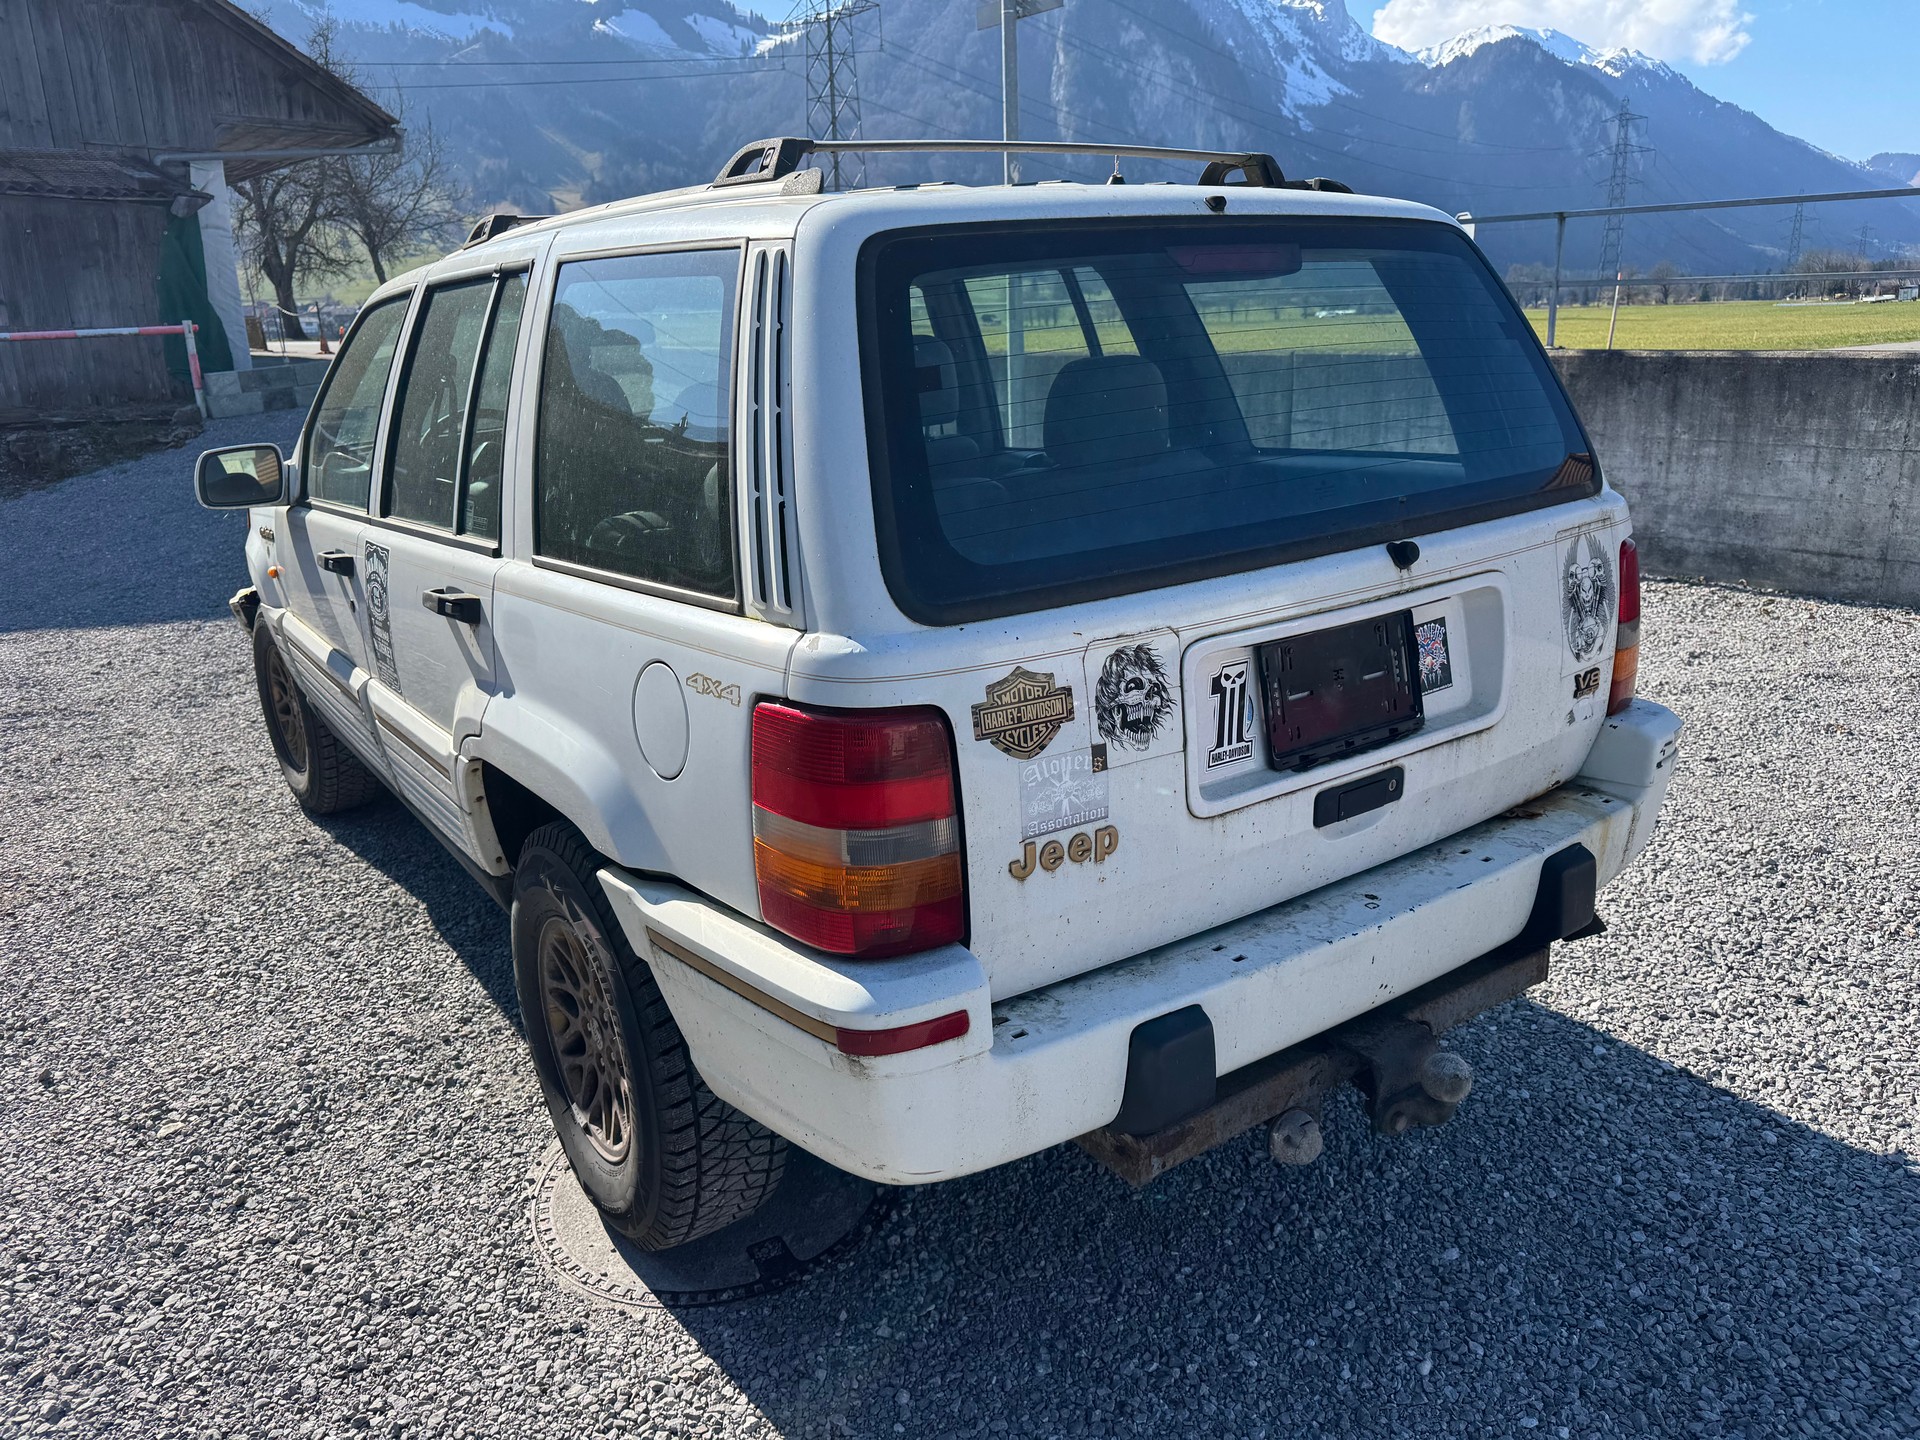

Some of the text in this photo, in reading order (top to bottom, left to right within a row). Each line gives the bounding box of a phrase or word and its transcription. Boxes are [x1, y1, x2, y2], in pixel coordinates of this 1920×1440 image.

[1001, 683, 1046, 705] MOTOR
[984, 698, 1063, 730] HARLEY-DAVIDSON
[1005, 723, 1046, 748] CYCLES
[1211, 744, 1250, 764] HARLEY-DAVIDSON
[1027, 807, 1106, 837] Association
[1009, 825, 1119, 879] Jeep
